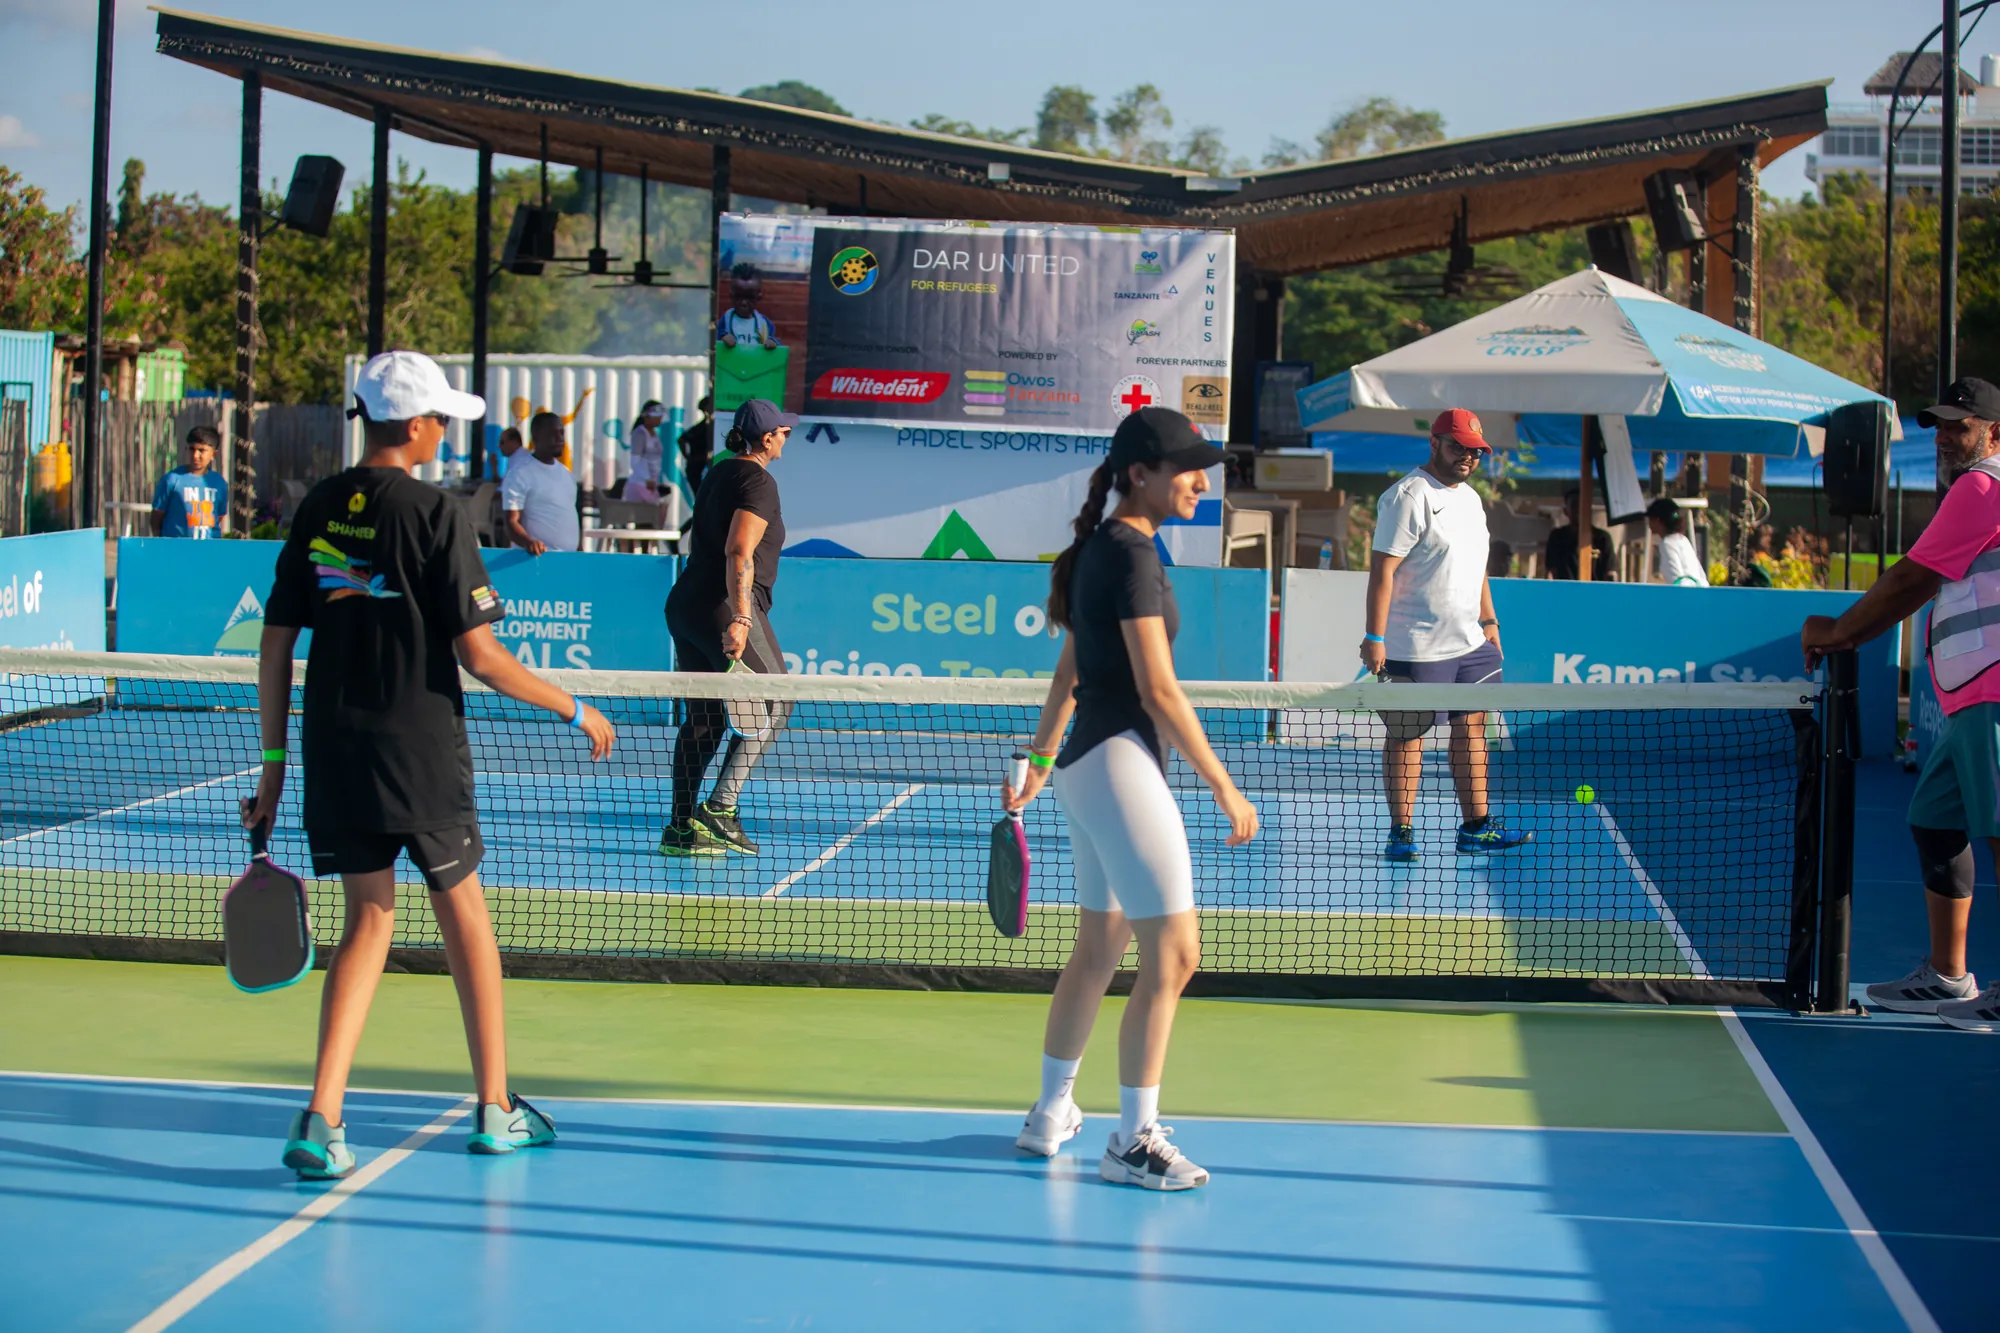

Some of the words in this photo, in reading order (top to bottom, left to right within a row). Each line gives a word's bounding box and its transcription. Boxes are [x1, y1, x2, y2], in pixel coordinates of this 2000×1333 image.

[913, 249, 970, 271] DAR
[979, 252, 1080, 275] UNITED
[911, 280, 934, 290] FOR
[937, 281, 997, 293] REFUGEES
[1114, 292, 1160, 300] TANZANITE
[998, 351, 1043, 360] POWERED
[1486, 345, 1564, 357] CRISP
[1136, 357, 1179, 366] FOREVER
[1180, 358, 1227, 367] PARTNERS
[1007, 372, 1055, 387] Owos
[1007, 386, 1081, 403] Tanzania
[897, 427, 974, 450] PADEL
[980, 430, 1068, 453] SPORTS
[184, 487, 199, 502] IN
[204, 487, 218, 502] IT
[24, 570, 43, 613] of
[498, 598, 592, 620] AINABLE
[871, 593, 997, 635] Steel
[1014, 604, 1060, 639] o
[491, 620, 592, 641] ELOPMENT
